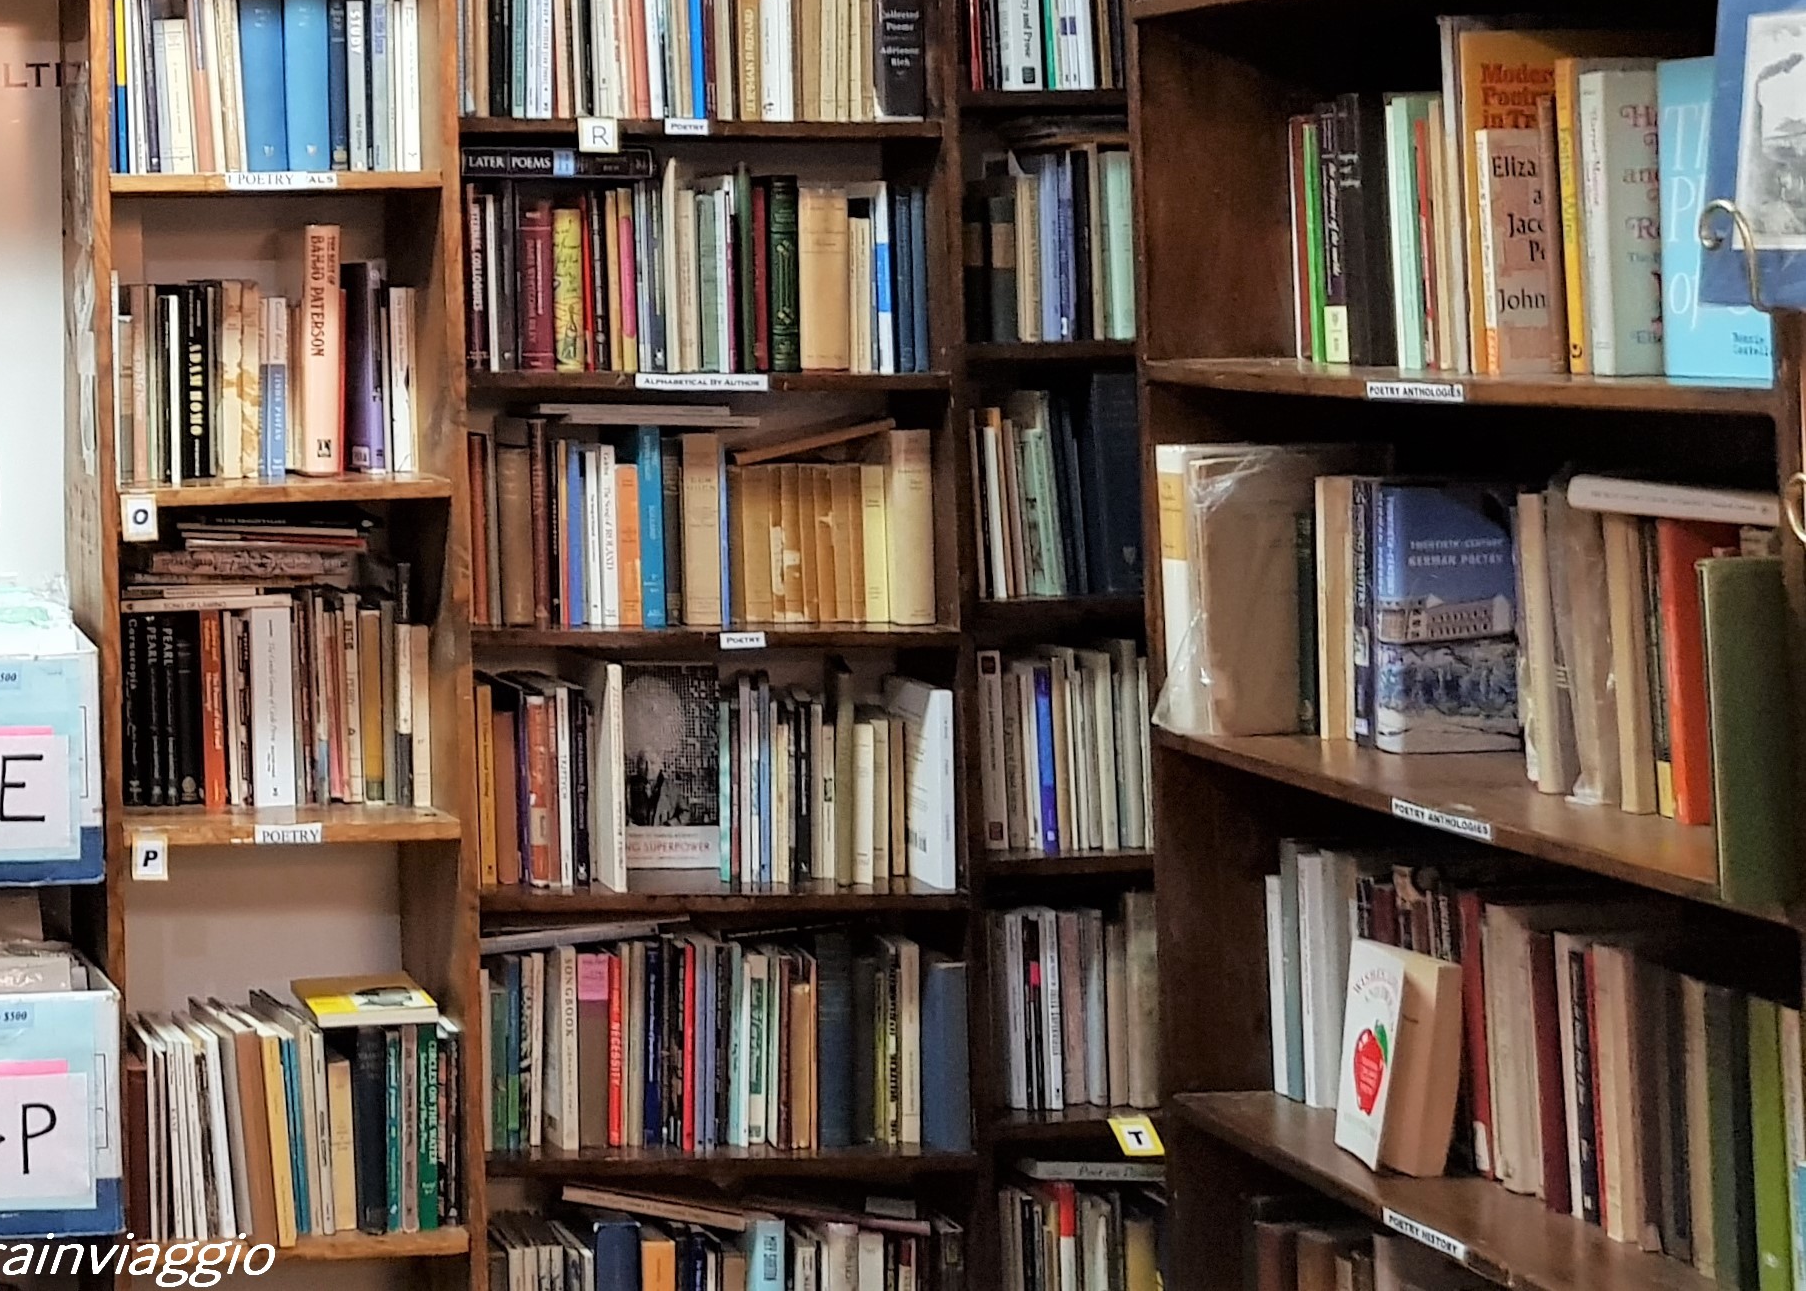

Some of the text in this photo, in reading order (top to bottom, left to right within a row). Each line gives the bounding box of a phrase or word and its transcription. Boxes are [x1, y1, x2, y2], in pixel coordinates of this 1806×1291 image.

[350, 10, 363, 54] STUDY
[591, 125, 609, 146] R
[468, 155, 552, 169] LATER POEMS
[237, 171, 294, 185] POETRY
[310, 235, 325, 357] BANJO PATERSON
[1495, 288, 1546, 312] John
[643, 378, 707, 387] ALPHABETICAL
[1369, 385, 1462, 398] POETRY ANTHOLOGIES
[134, 509, 149, 525] O
[1407, 553, 1503, 568] GERMAN POETRY
[147, 626, 157, 665] PEARL
[163, 627, 173, 667] PEARL
[725, 636, 760, 644] POETRY
[1393, 802, 1489, 835] POETRY ANTHOLOGIES
[262, 829, 320, 842] POETRY
[143, 850, 158, 867] P
[564, 958, 575, 1038] SONGBOOK
[3, 1010, 29, 1023] $500
[21, 1102, 57, 1175] P
[1128, 1130, 1144, 1146] T
[1388, 1214, 1459, 1254] POETRY HISTORY
